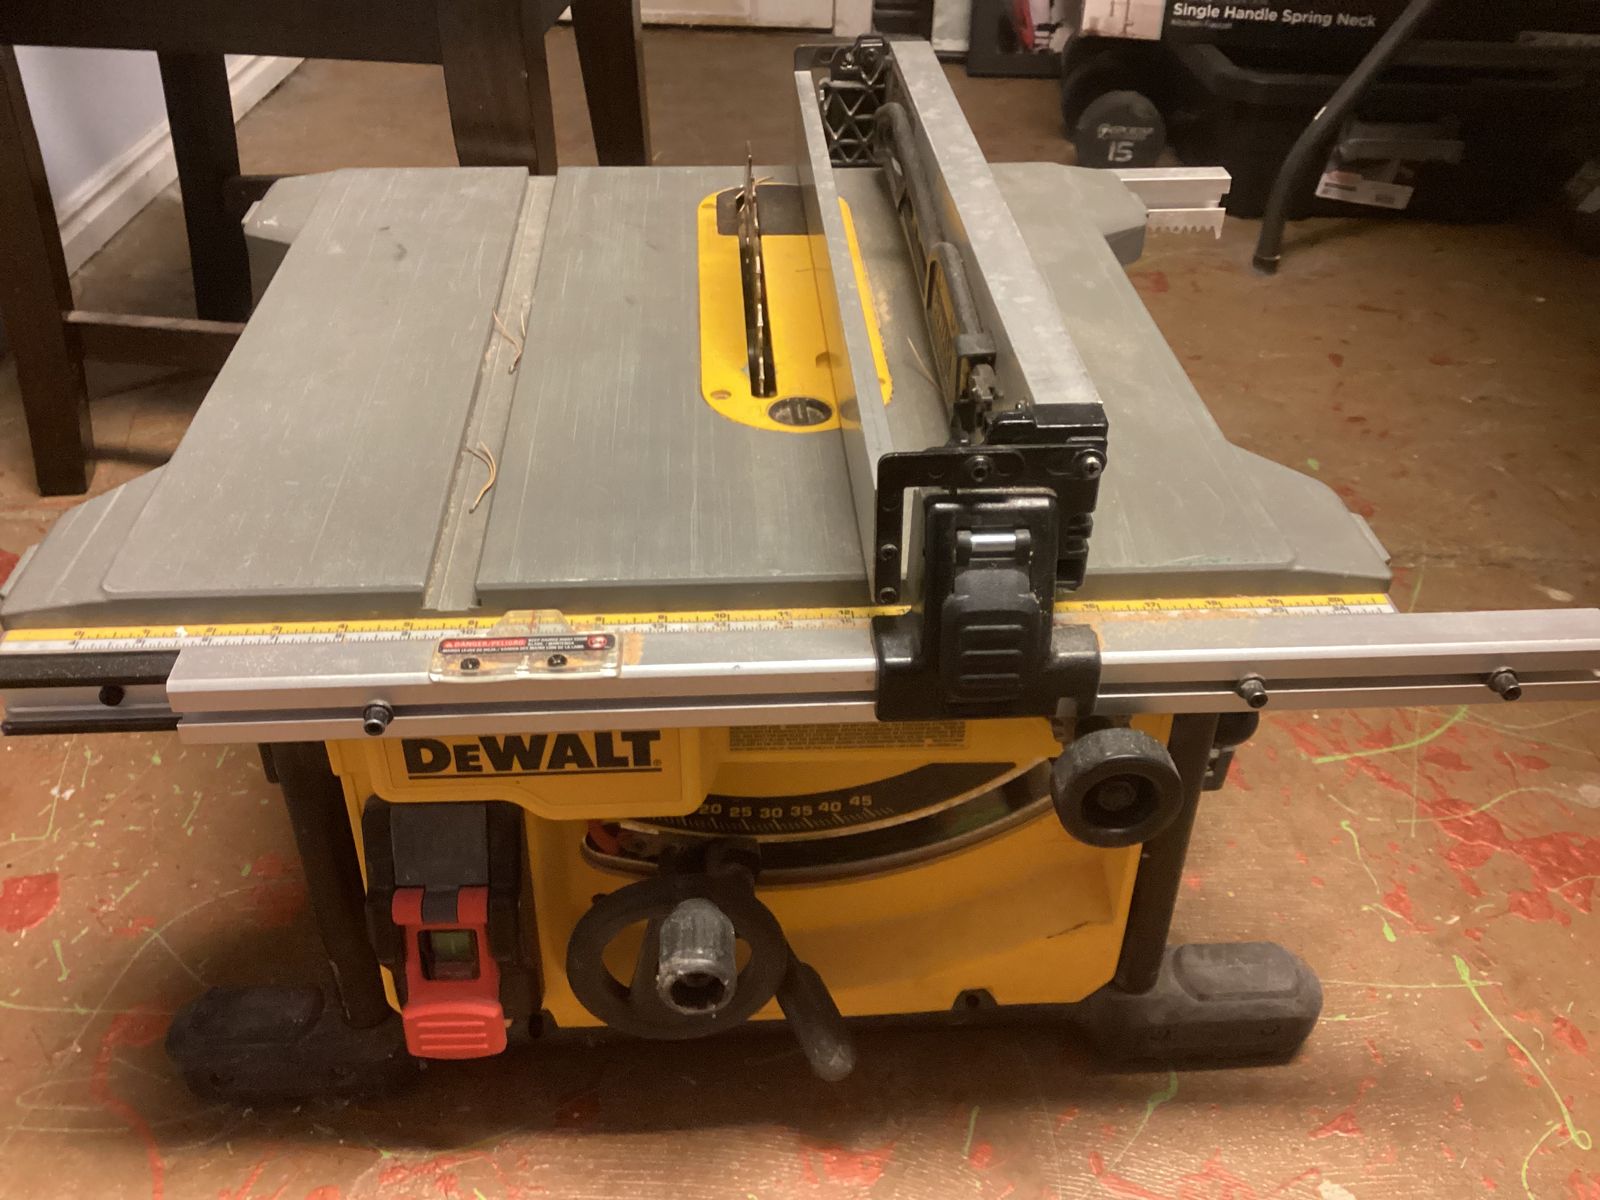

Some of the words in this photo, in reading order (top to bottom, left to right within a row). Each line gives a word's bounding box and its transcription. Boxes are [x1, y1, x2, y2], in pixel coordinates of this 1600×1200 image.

[1173, 3, 1220, 19] Single
[1224, 6, 1278, 21] Handle
[1282, 9, 1333, 27] Spring
[1337, 13, 1376, 28] Neck
[1108, 141, 1134, 162] 15
[700, 804, 722, 814] 20
[730, 806, 752, 817] 25
[760, 807, 783, 818] 30
[790, 805, 812, 816] 35
[818, 801, 841, 812] 40
[850, 795, 872, 806] 45
